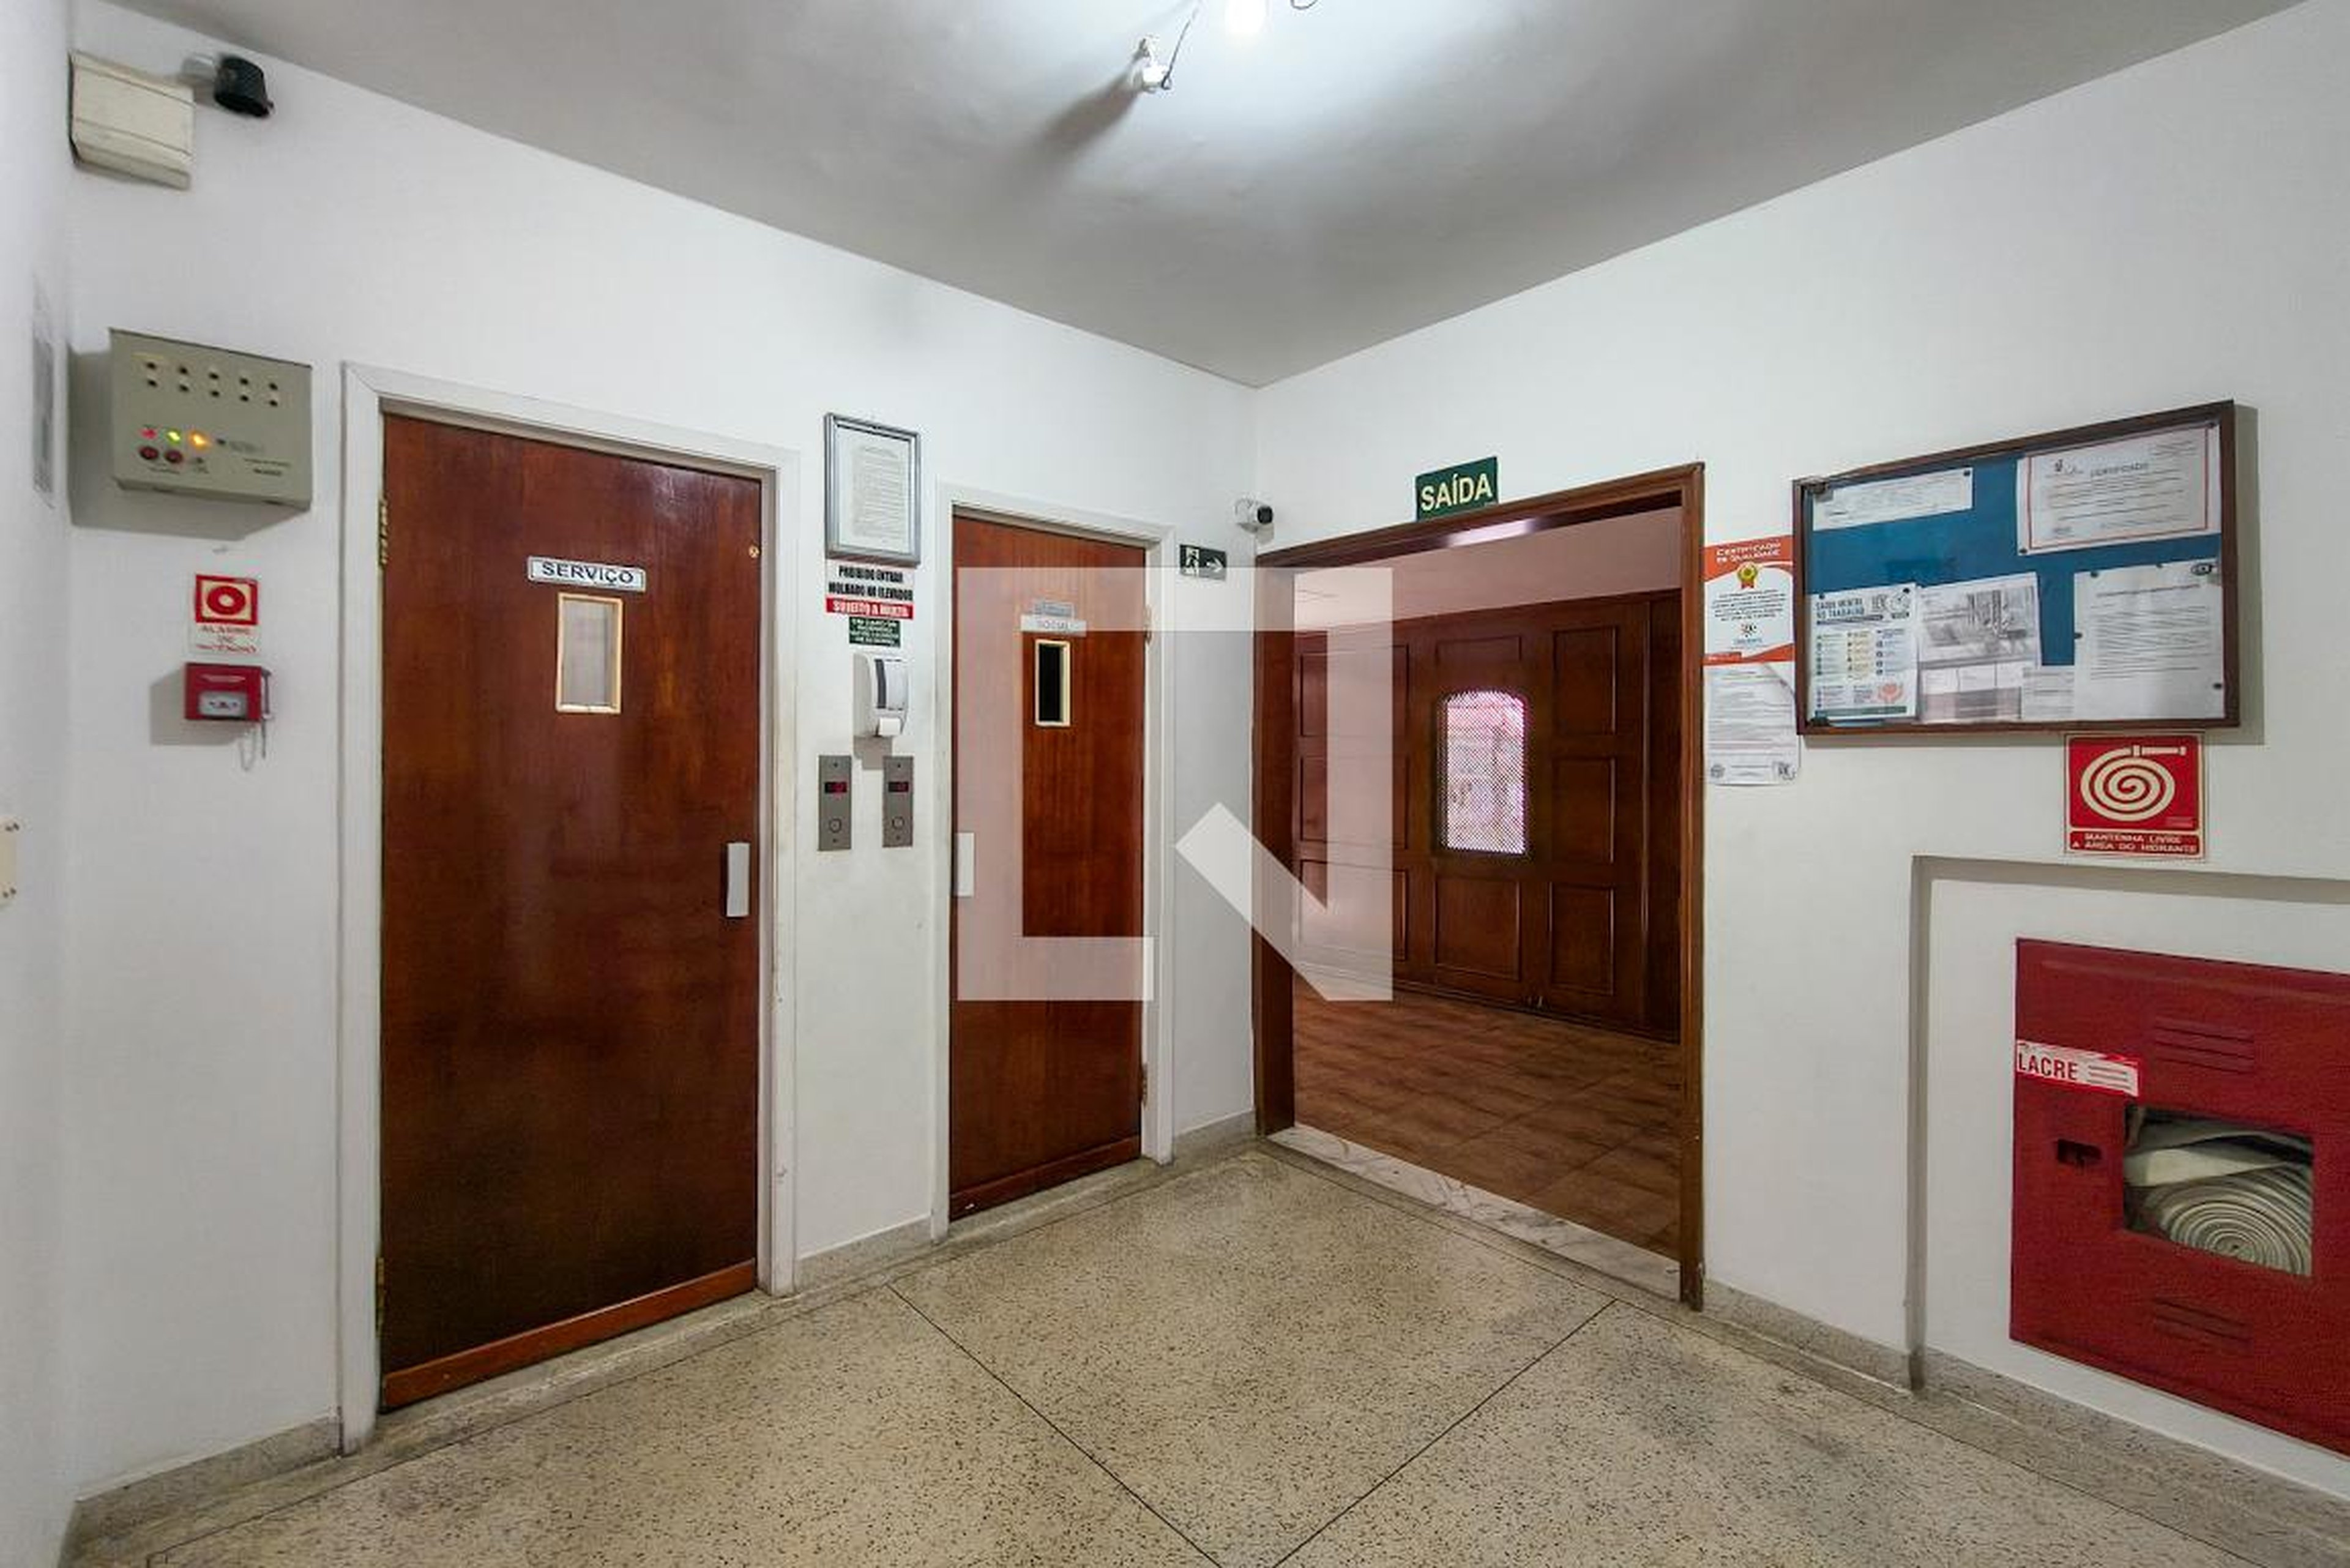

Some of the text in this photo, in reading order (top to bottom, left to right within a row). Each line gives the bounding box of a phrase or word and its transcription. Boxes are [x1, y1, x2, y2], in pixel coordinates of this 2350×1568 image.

[1421, 473, 1492, 511] SAÍDA
[542, 561, 634, 586] SERVIÇO
[2084, 833, 2180, 844] MANTENHA LIVRE
[2018, 1053, 2077, 1080] LACRE
